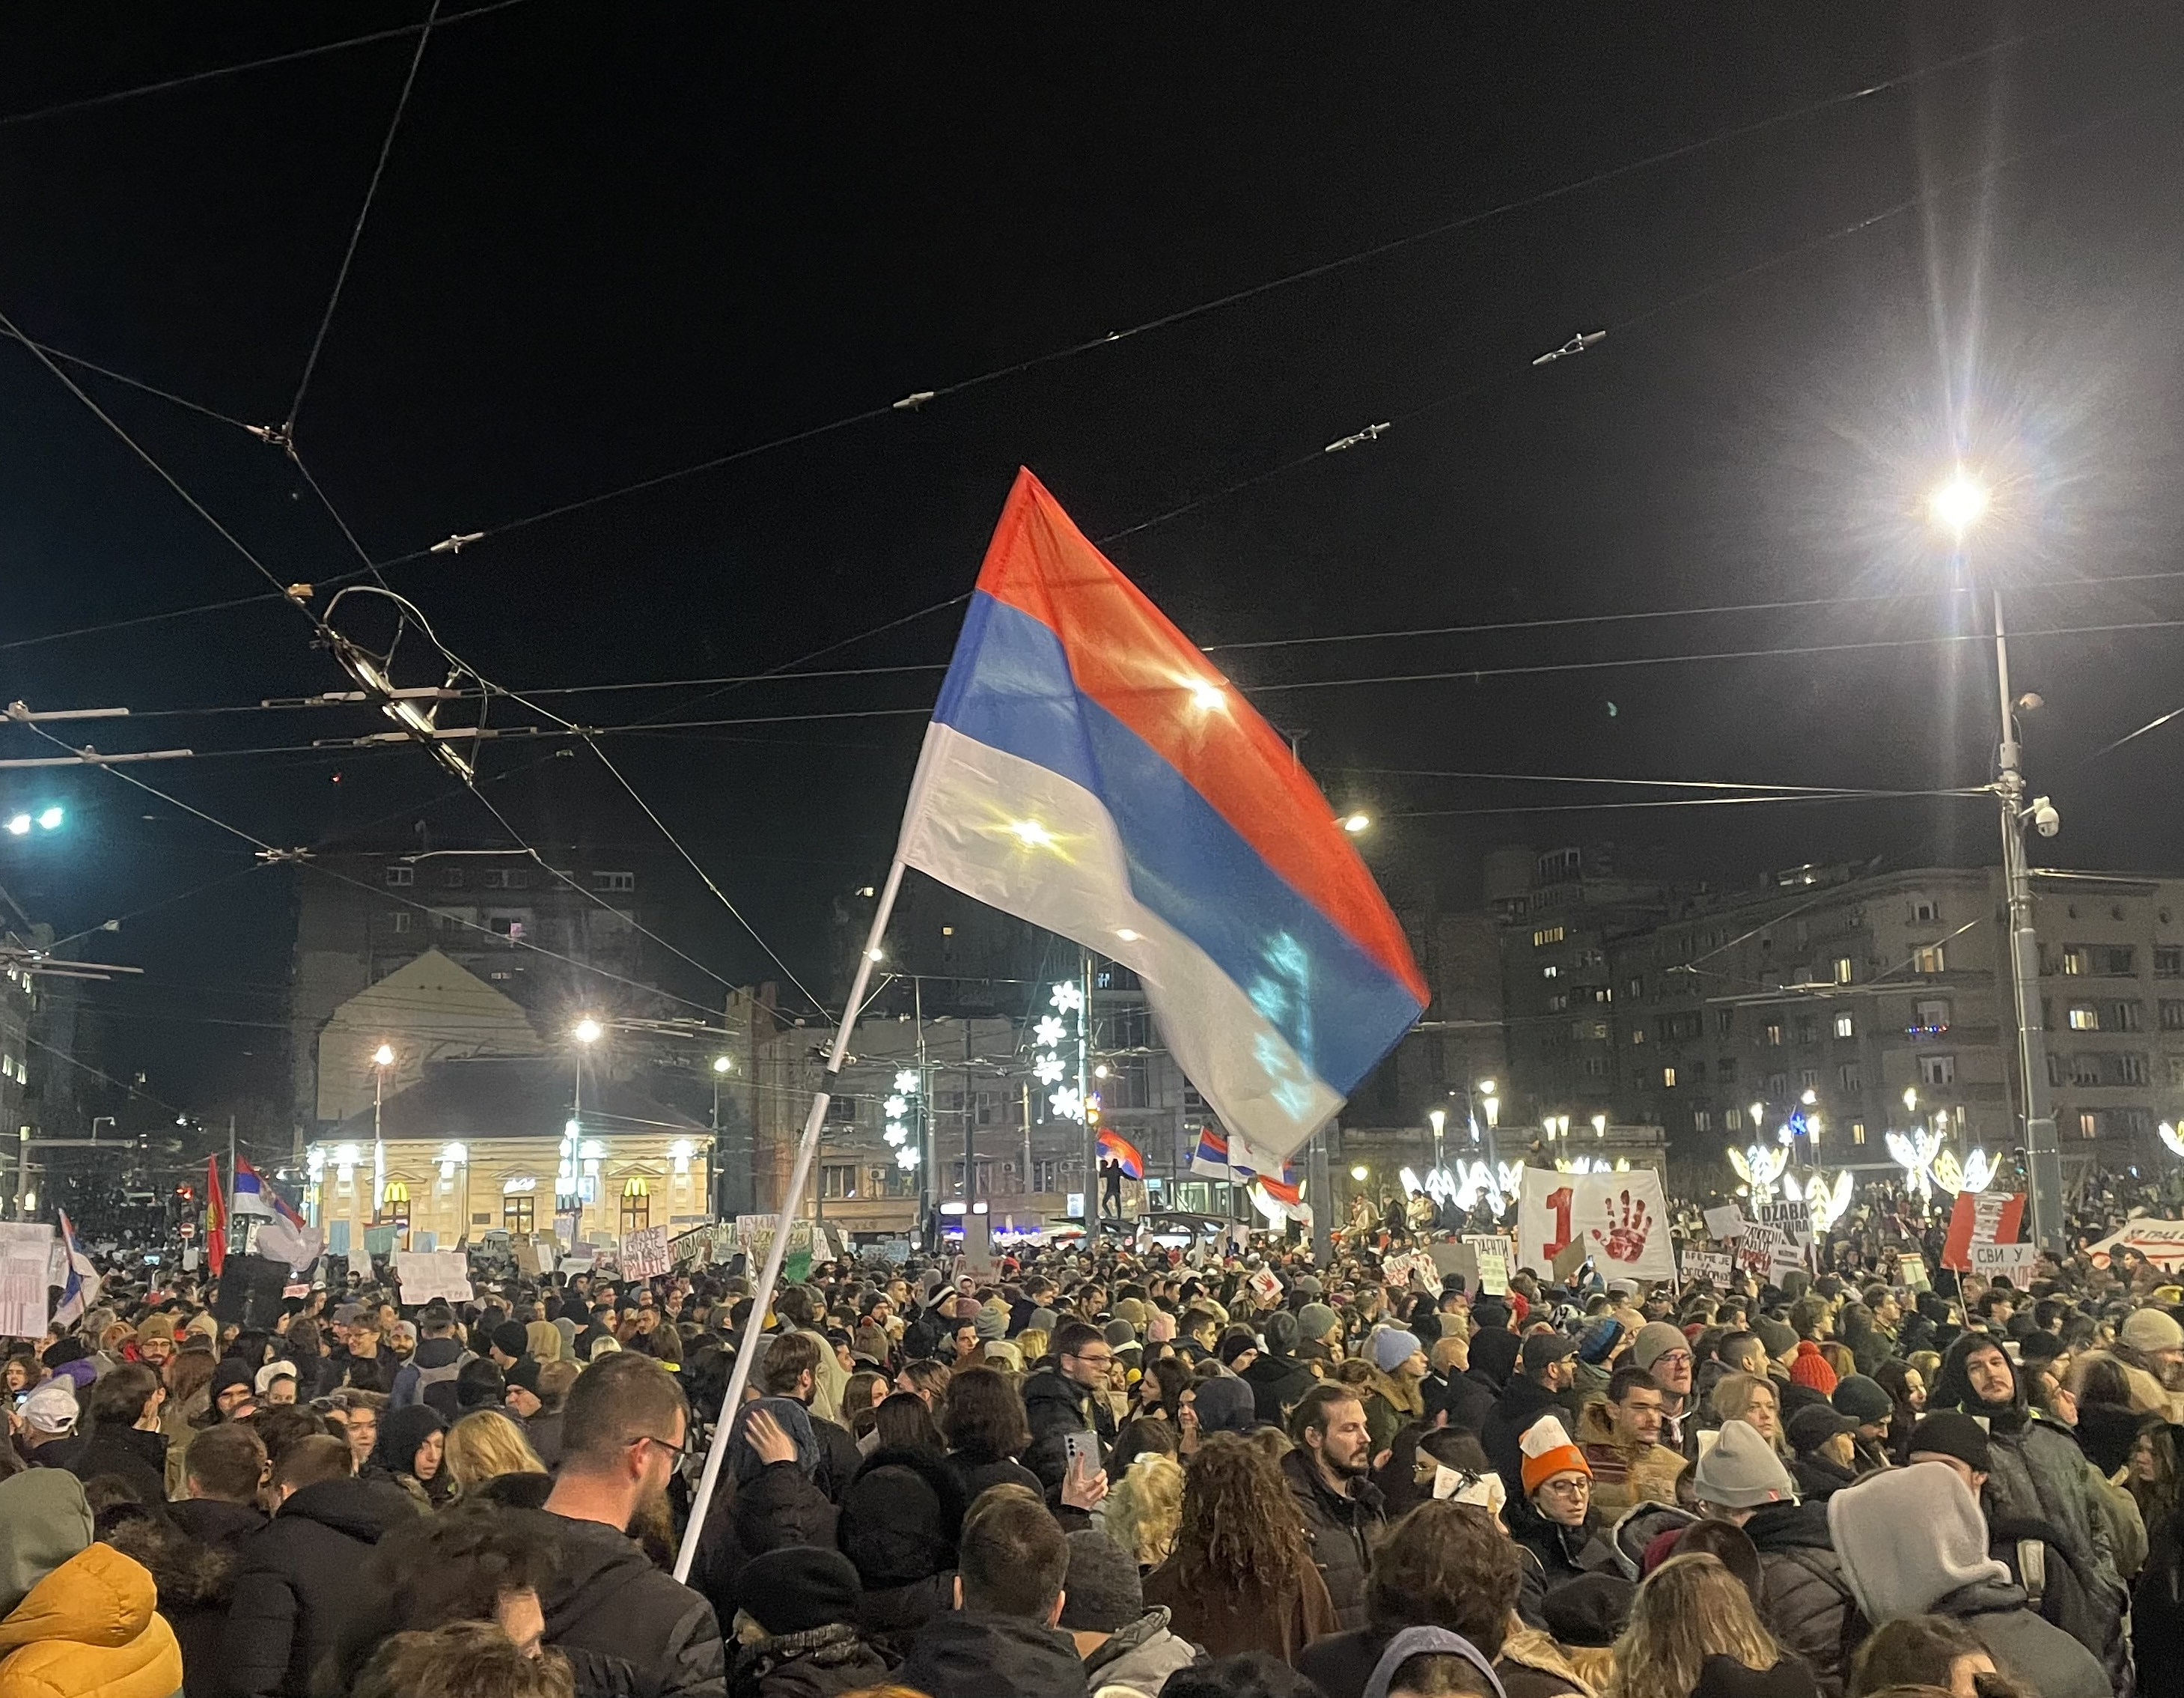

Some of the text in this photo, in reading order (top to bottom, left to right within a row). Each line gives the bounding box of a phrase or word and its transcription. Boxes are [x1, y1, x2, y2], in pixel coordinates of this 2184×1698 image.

[1543, 1187, 1573, 1260] 1
[1465, 1238, 1509, 1258] УДЕНТИ
[1977, 1248, 2023, 1263] СВИ У
